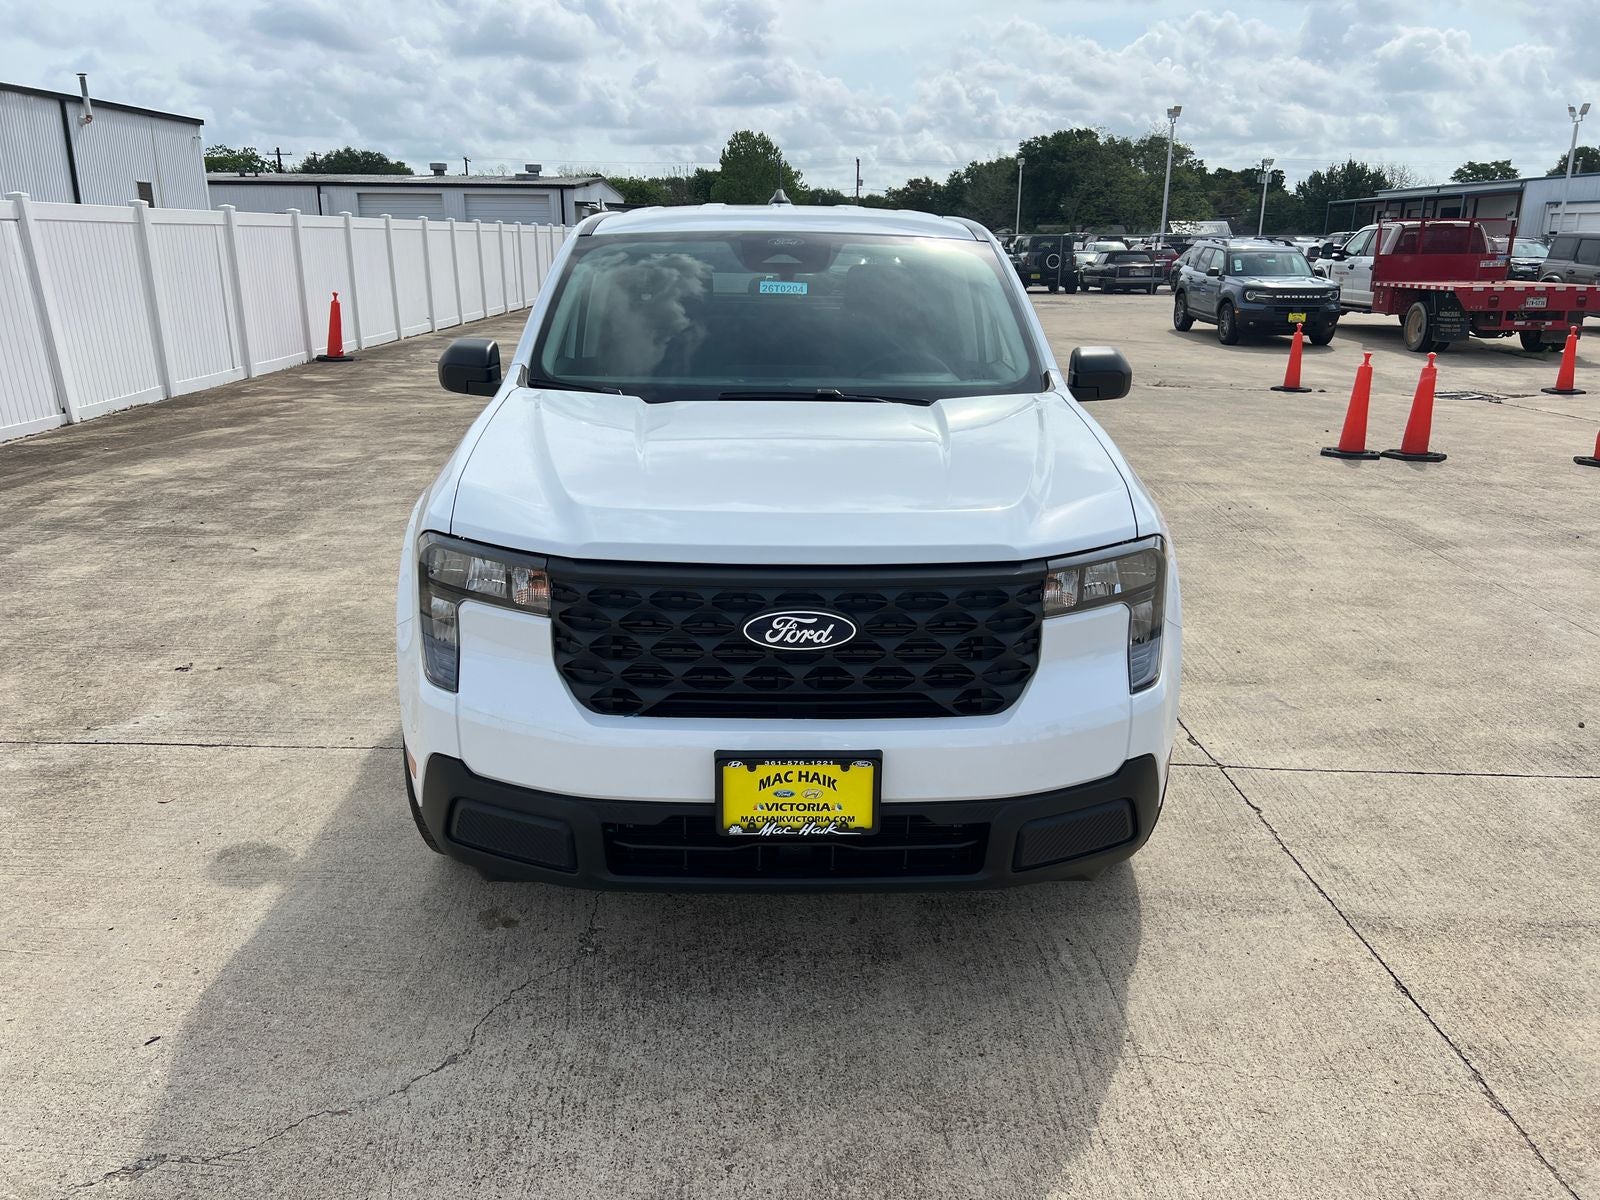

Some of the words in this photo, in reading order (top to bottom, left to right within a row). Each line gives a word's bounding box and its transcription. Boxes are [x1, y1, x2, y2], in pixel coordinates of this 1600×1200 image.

[761, 284, 804, 293] 26T0204
[765, 616, 835, 644] Ford
[758, 770, 794, 791] MAC
[797, 770, 838, 791] HAIK
[765, 802, 831, 812] VICTORIA
[740, 815, 856, 823] MACHAIKVICTORIA.COM
[758, 822, 797, 836] Mac
[798, 822, 842, 836] Haik
